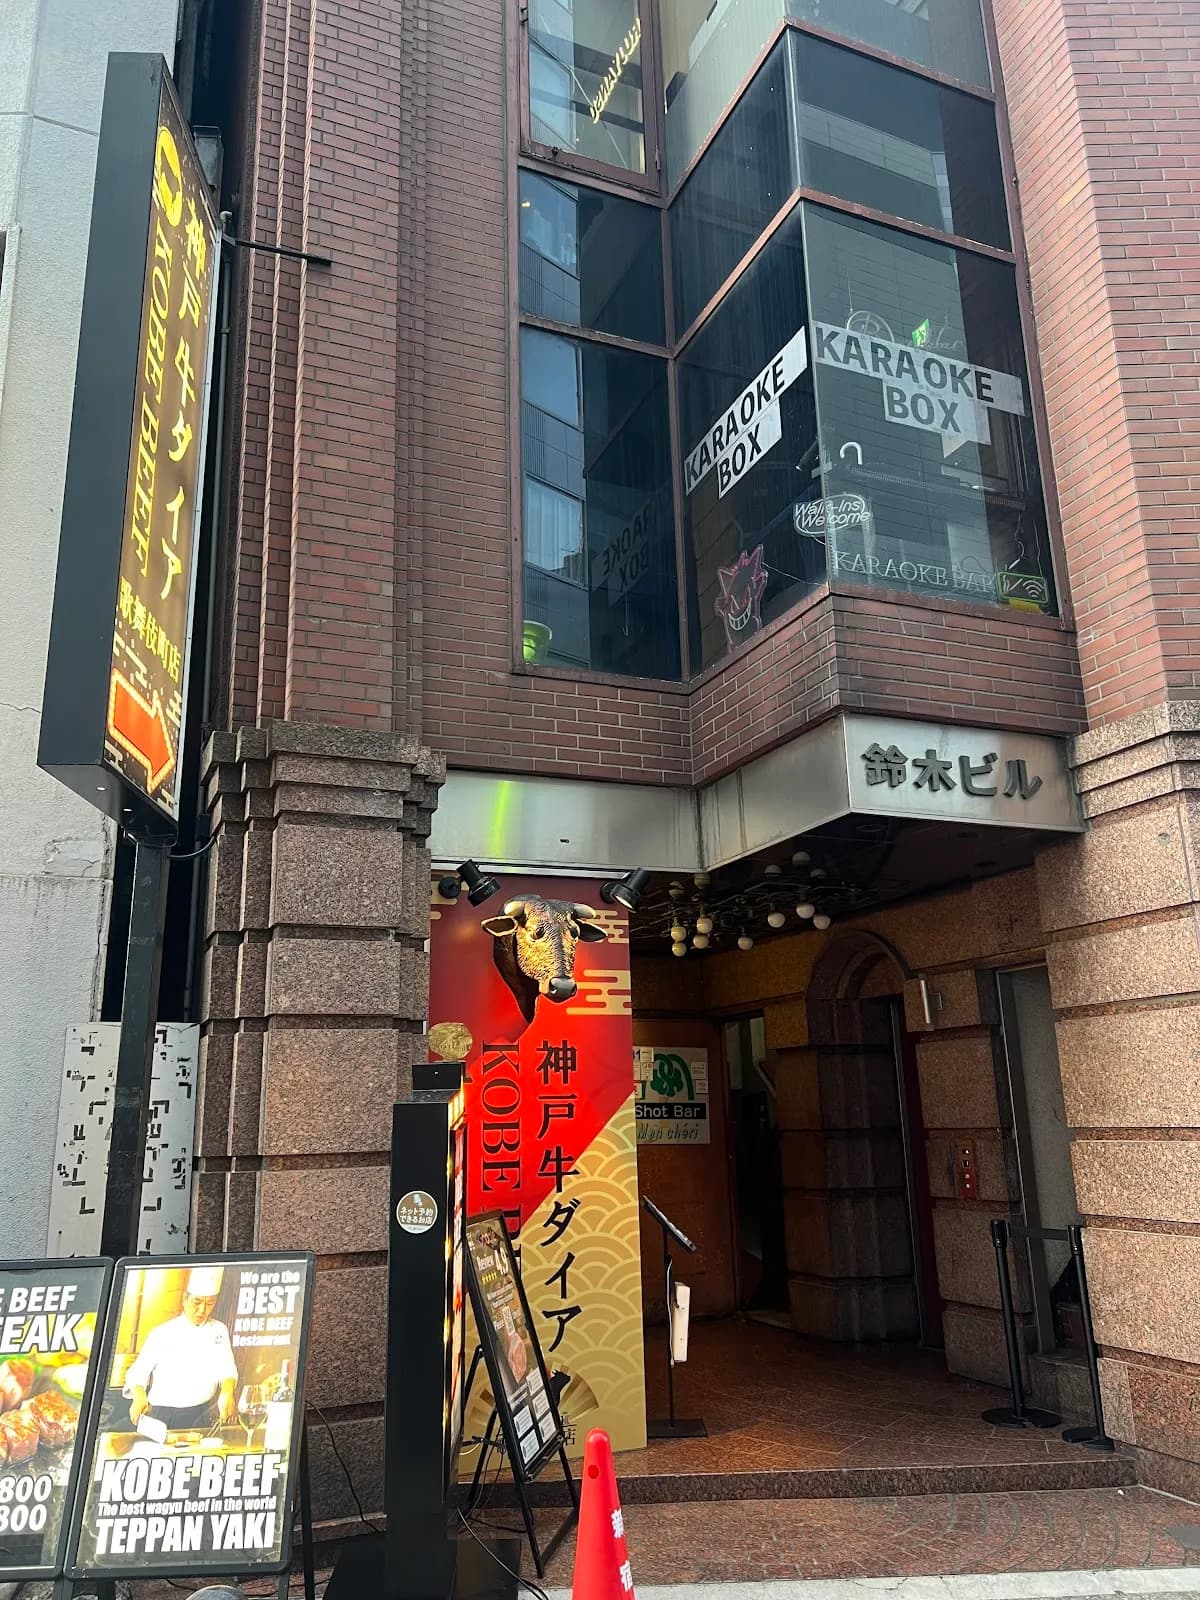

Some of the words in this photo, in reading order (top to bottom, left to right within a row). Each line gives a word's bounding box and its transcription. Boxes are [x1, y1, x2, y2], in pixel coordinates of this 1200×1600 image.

[144, 216, 173, 404] KOBE
[815, 326, 995, 404] KARAOKE
[686, 354, 786, 487] KARAOKE
[886, 385, 961, 433] BOX
[718, 426, 761, 491] BOX
[131, 392, 160, 577] BEEF
[801, 511, 871, 528] Wecome
[833, 551, 949, 586] KARAOKE
[861, 742, 1044, 800] 鈴木ビル
[481, 1040, 522, 1193] KOBE
[636, 1104, 668, 1118] Shot
[674, 1105, 701, 1118] Bar
[400, 1207, 433, 1216] ネット予約
[535, 1039, 584, 1353] 神戸牛ダイア
[400, 1215, 433, 1224] できるお店
[240, 1272, 259, 1284] We
[260, 1271, 280, 1284] are
[281, 1270, 300, 1283] the
[494, 1246, 509, 1276] 4.9
[9, 1285, 78, 1312] BEEF
[237, 1286, 300, 1314] BEST
[0, 1314, 84, 1353] EAK
[234, 1318, 265, 1331] KOBE
[266, 1316, 294, 1330] BEEF
[0, 1475, 52, 1503] 800
[99, 1456, 194, 1502] KOBE
[199, 1454, 281, 1498] BEEF
[97, 1503, 118, 1516] The
[119, 1502, 145, 1516] best
[146, 1500, 183, 1516] wagyu
[184, 1498, 208, 1513] beef
[210, 1498, 222, 1511] in
[224, 1498, 243, 1511] the
[245, 1496, 277, 1511] world
[95, 1515, 203, 1555] TEPPAN
[210, 1512, 276, 1550] YAKI
